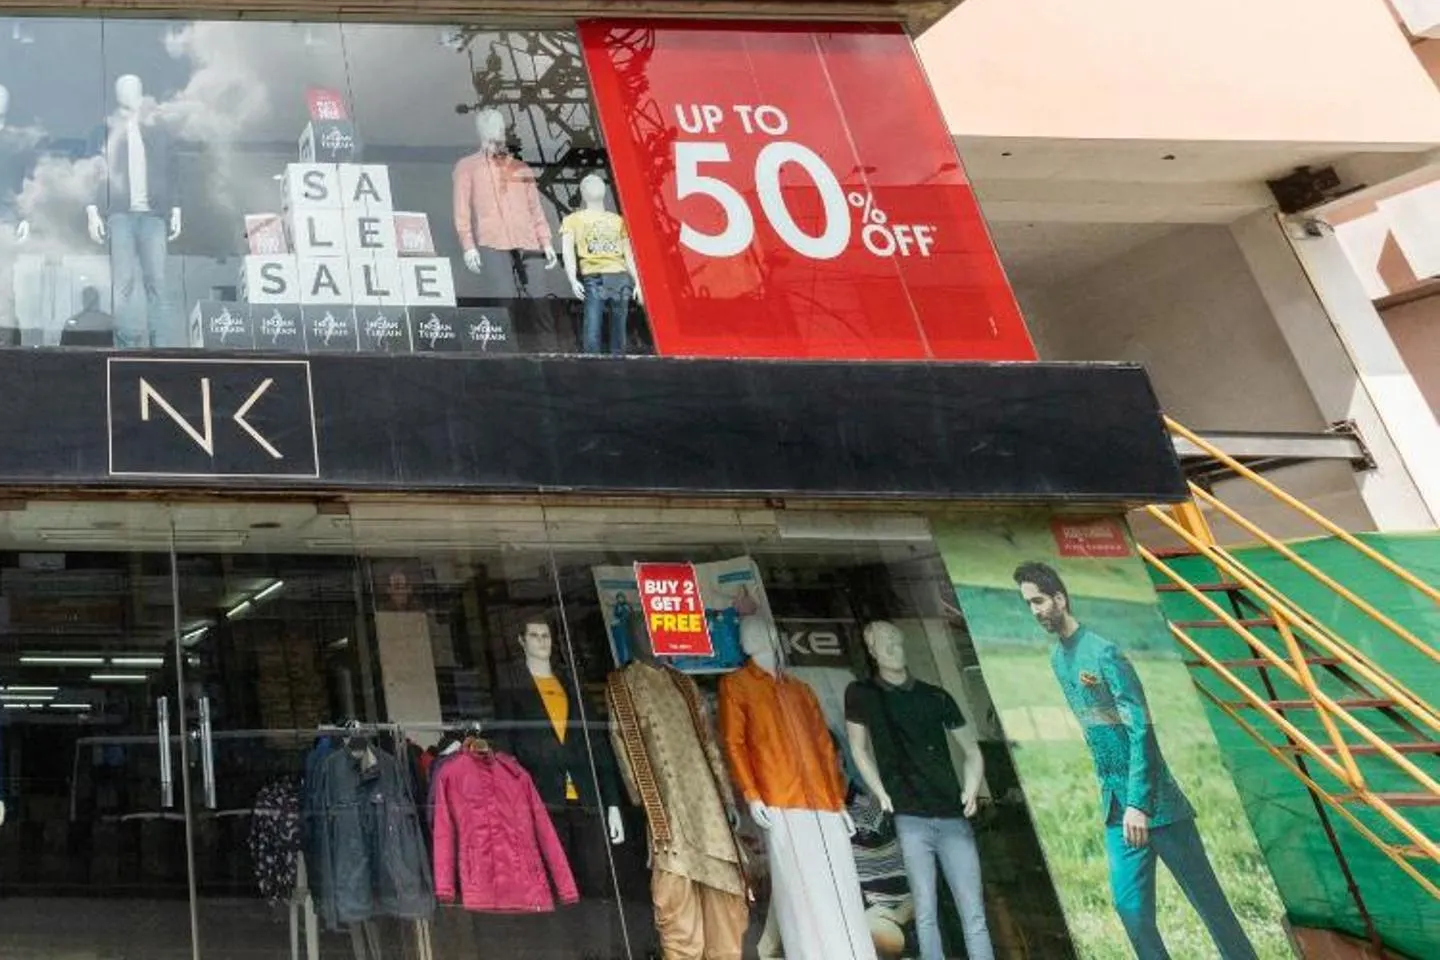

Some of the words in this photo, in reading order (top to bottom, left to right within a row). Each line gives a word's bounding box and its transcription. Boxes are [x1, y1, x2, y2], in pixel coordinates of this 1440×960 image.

[674, 104, 723, 134] UP
[733, 104, 788, 135] TO
[674, 141, 851, 260] 50
[862, 224, 935, 257] OFF
[261, 262, 441, 298] SALE
[140, 376, 283, 459] NK
[644, 580, 679, 595] BUY
[683, 581, 694, 594] 2
[651, 597, 681, 611] GET
[686, 597, 695, 611] 1
[650, 614, 702, 633] FREE
